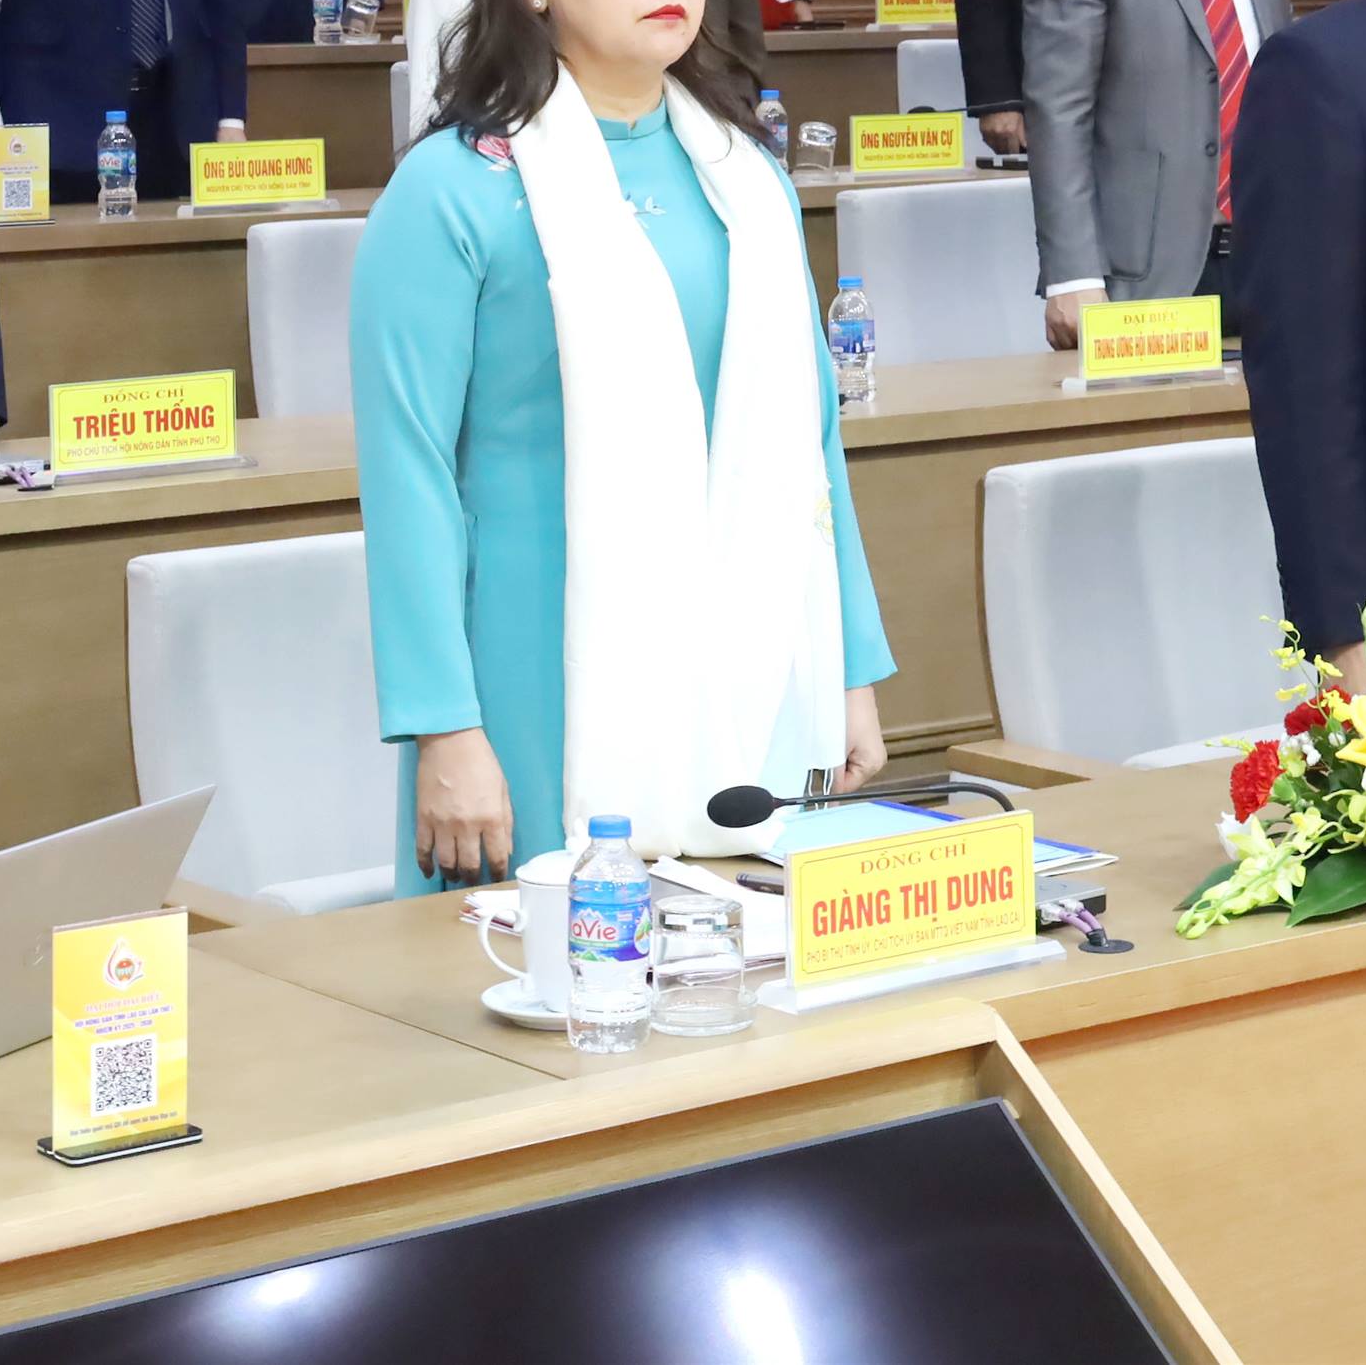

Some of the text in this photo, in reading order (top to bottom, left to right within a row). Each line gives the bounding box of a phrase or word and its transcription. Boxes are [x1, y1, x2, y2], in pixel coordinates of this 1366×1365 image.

[861, 130, 879, 149] ÔNG
[882, 125, 917, 148] NGUYỄN
[921, 128, 938, 146] VĂN
[204, 157, 312, 179] ÔNG BÙI QUANG HƯNG
[1094, 339, 1114, 359] TRUNG
[1147, 331, 1164, 355] NÔNG
[1181, 328, 1192, 357] VIỆT
[1194, 331, 1208, 351] NAM
[104, 385, 184, 403] ĐỒNG CHÍ
[73, 399, 214, 442] TRIỆU THỐNG
[133, 440, 154, 451] NÔNG
[860, 838, 967, 874] ĐỒNG CHÍ
[813, 866, 1013, 937] GIÀNG THỊ DUNG
